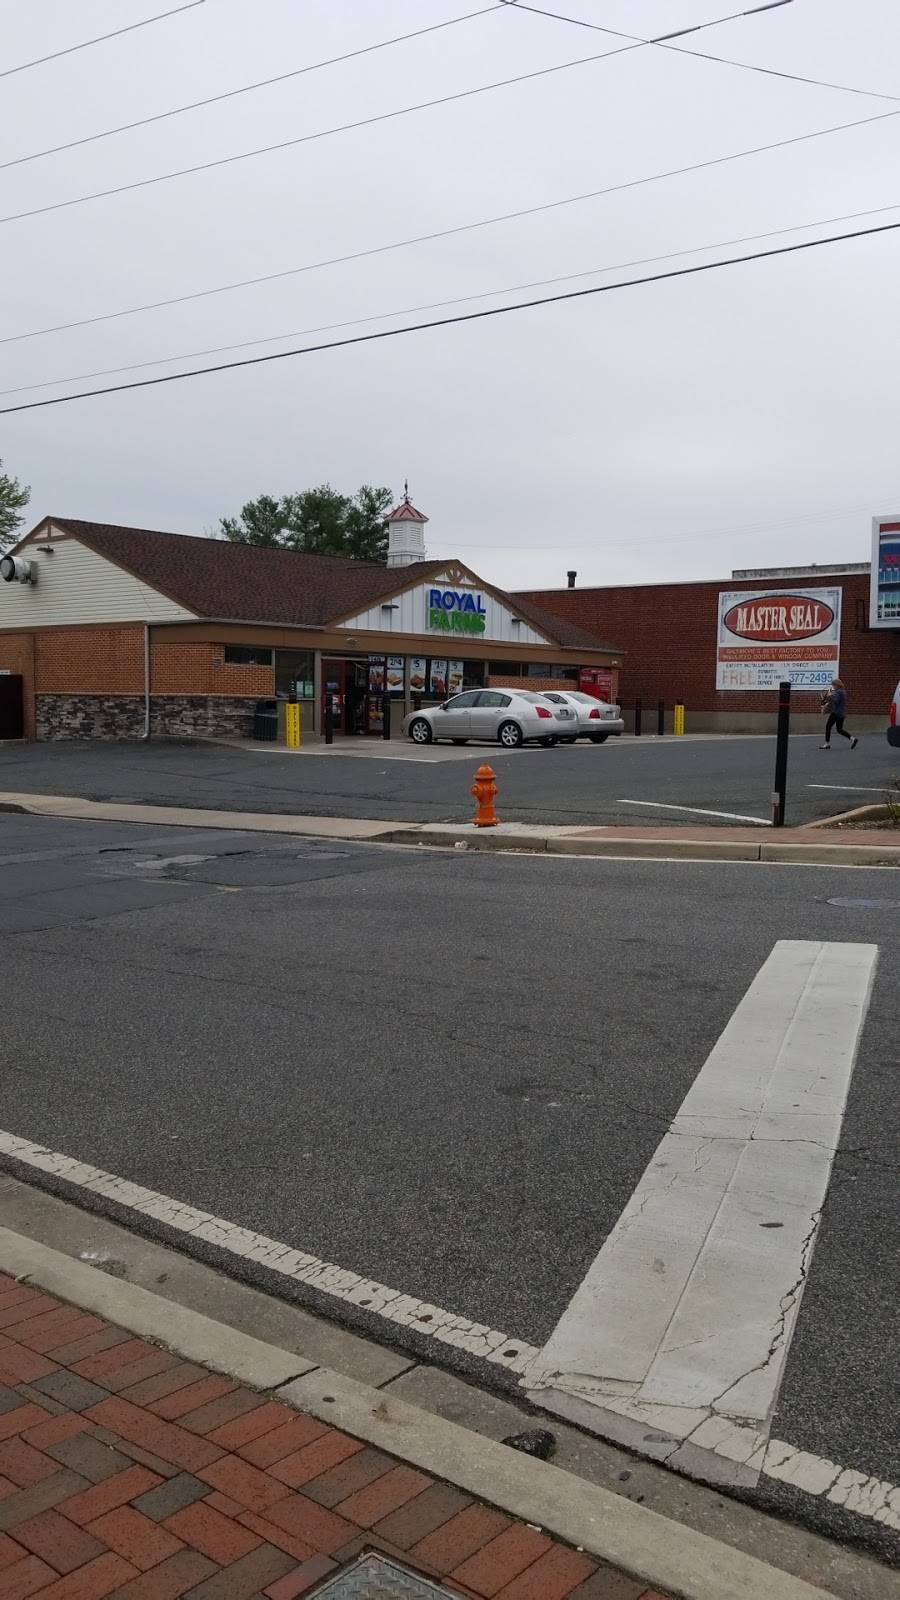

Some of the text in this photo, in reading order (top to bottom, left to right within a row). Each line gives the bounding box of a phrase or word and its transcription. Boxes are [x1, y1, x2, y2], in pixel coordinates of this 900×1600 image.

[429, 588, 486, 614] ROYAL
[429, 609, 486, 633] FARMS
[736, 605, 822, 636] MASTER SEAL
[789, 673, 833, 683] 377-2495
